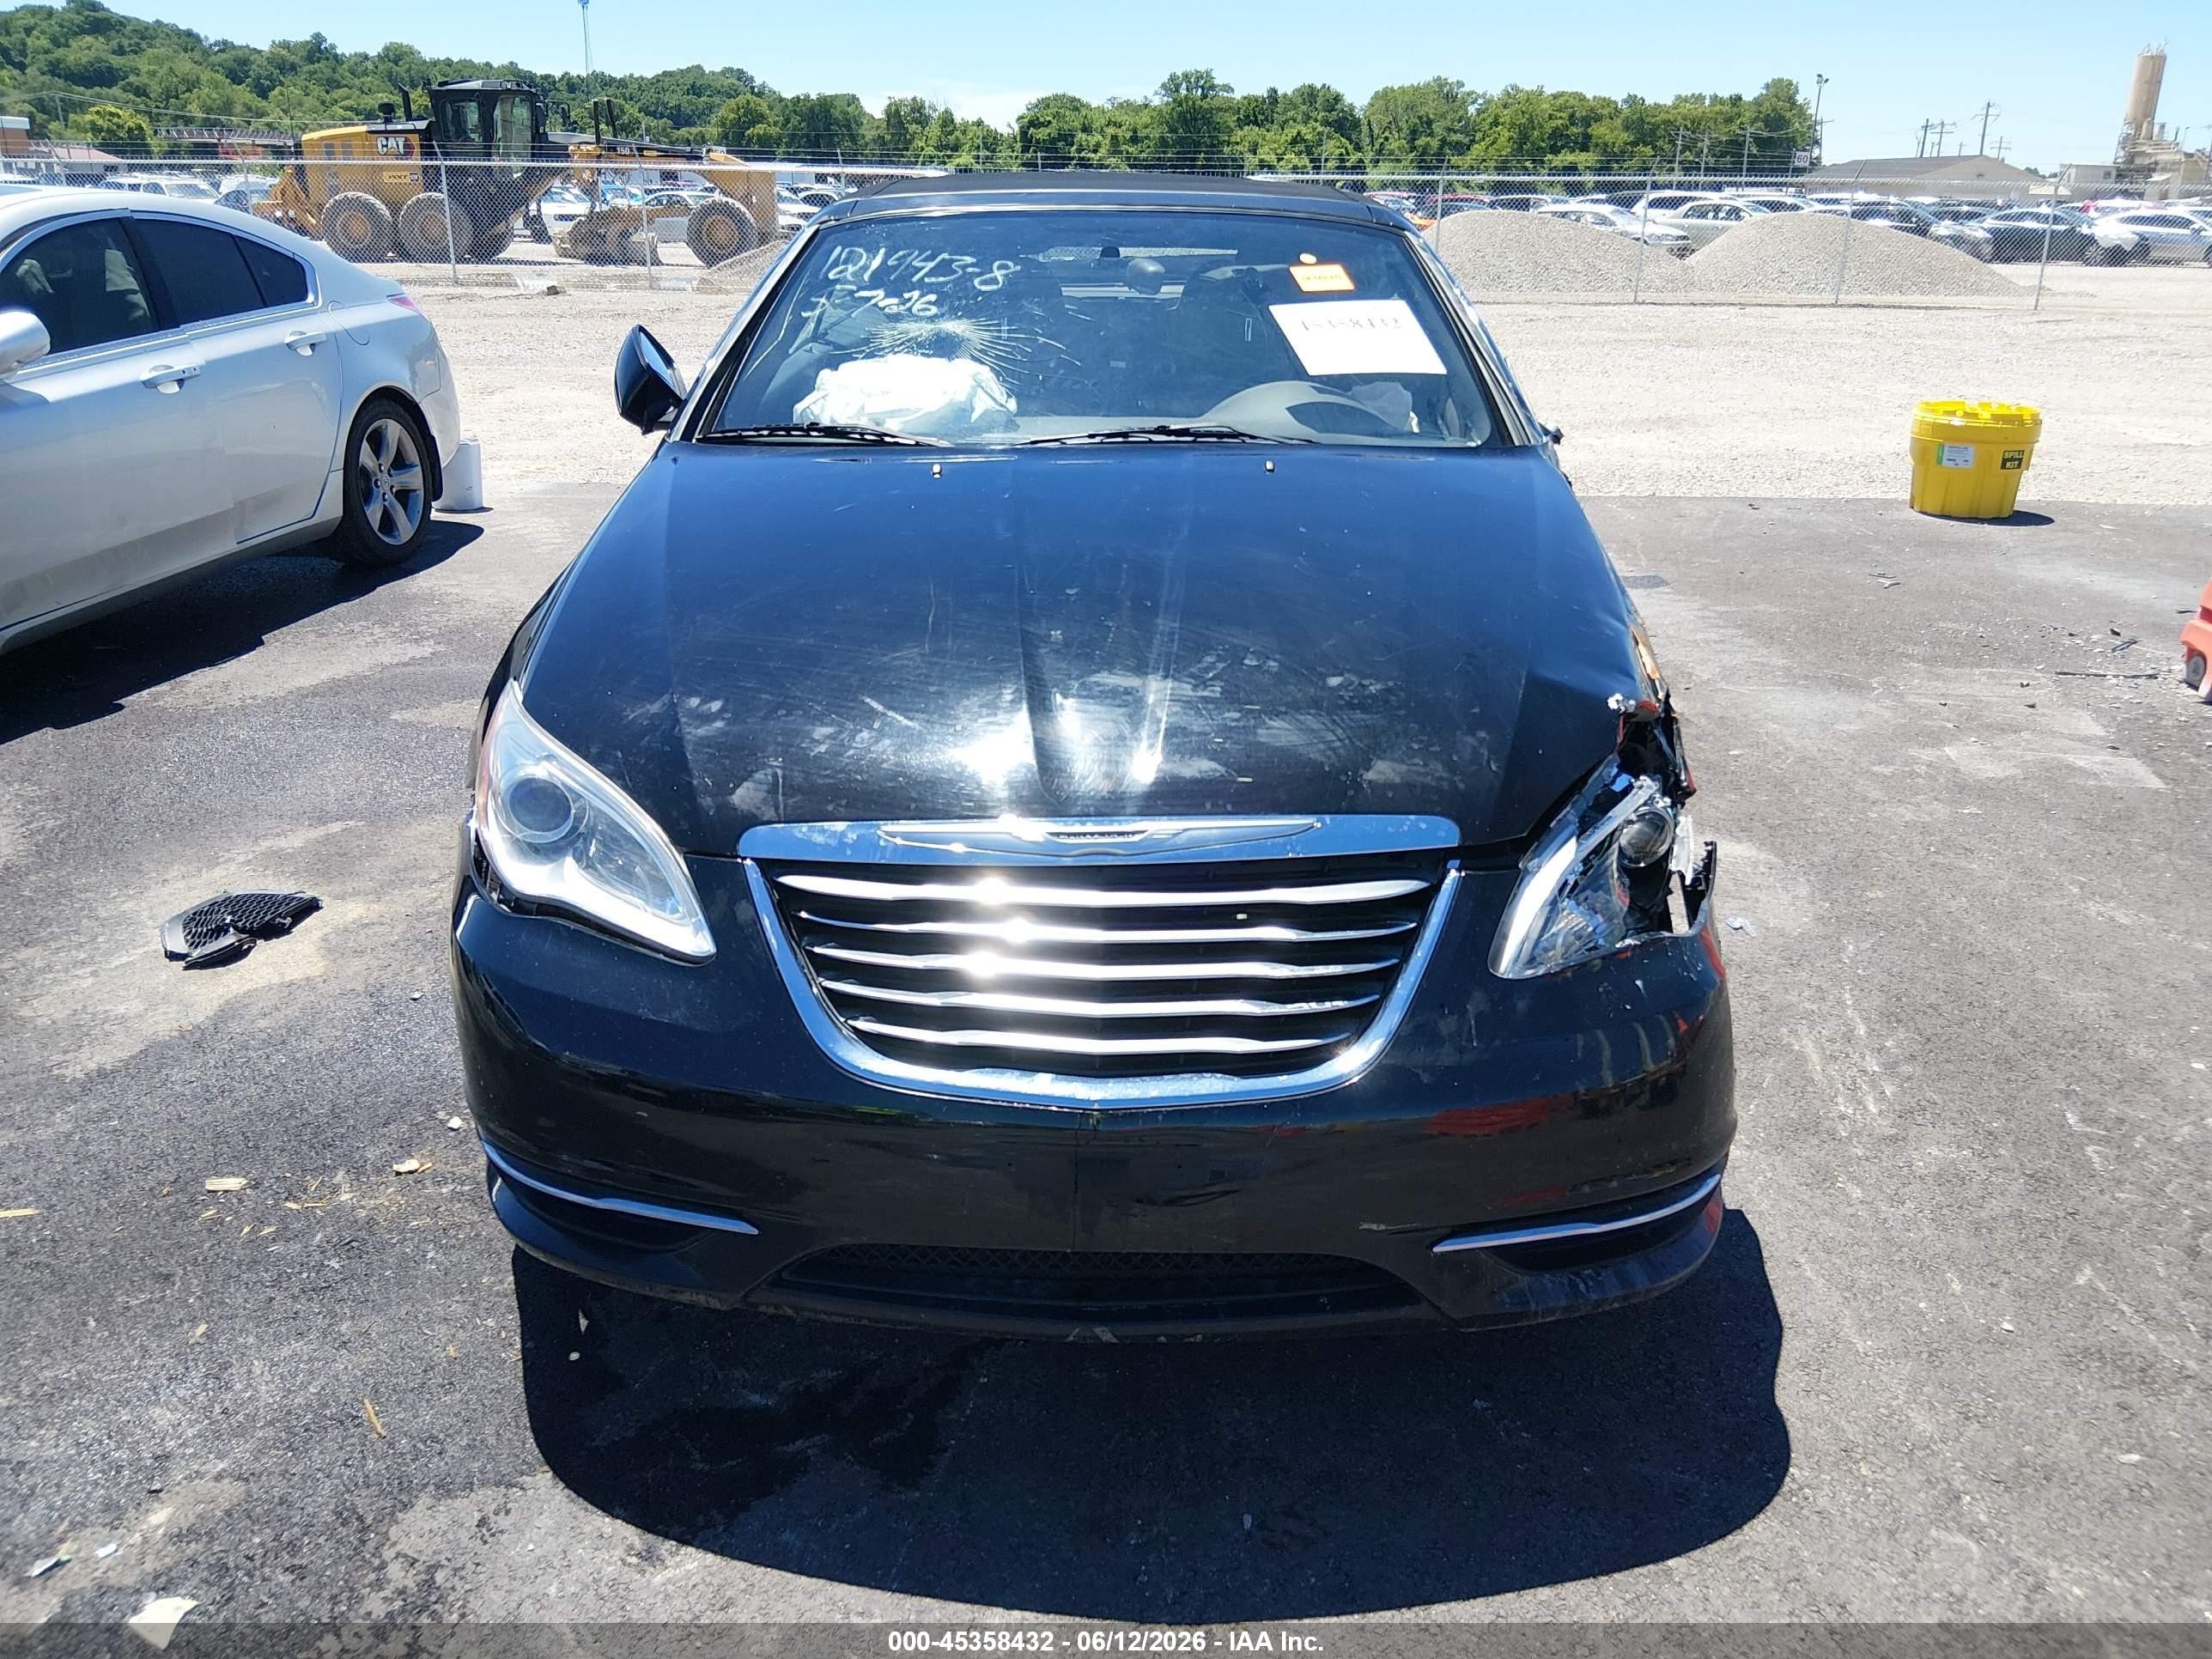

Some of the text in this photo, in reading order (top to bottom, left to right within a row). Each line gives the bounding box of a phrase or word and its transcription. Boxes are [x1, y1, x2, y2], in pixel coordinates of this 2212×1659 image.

[377, 137, 405, 155] CAT
[617, 146, 630, 155] 150
[1796, 155, 1808, 163] 60
